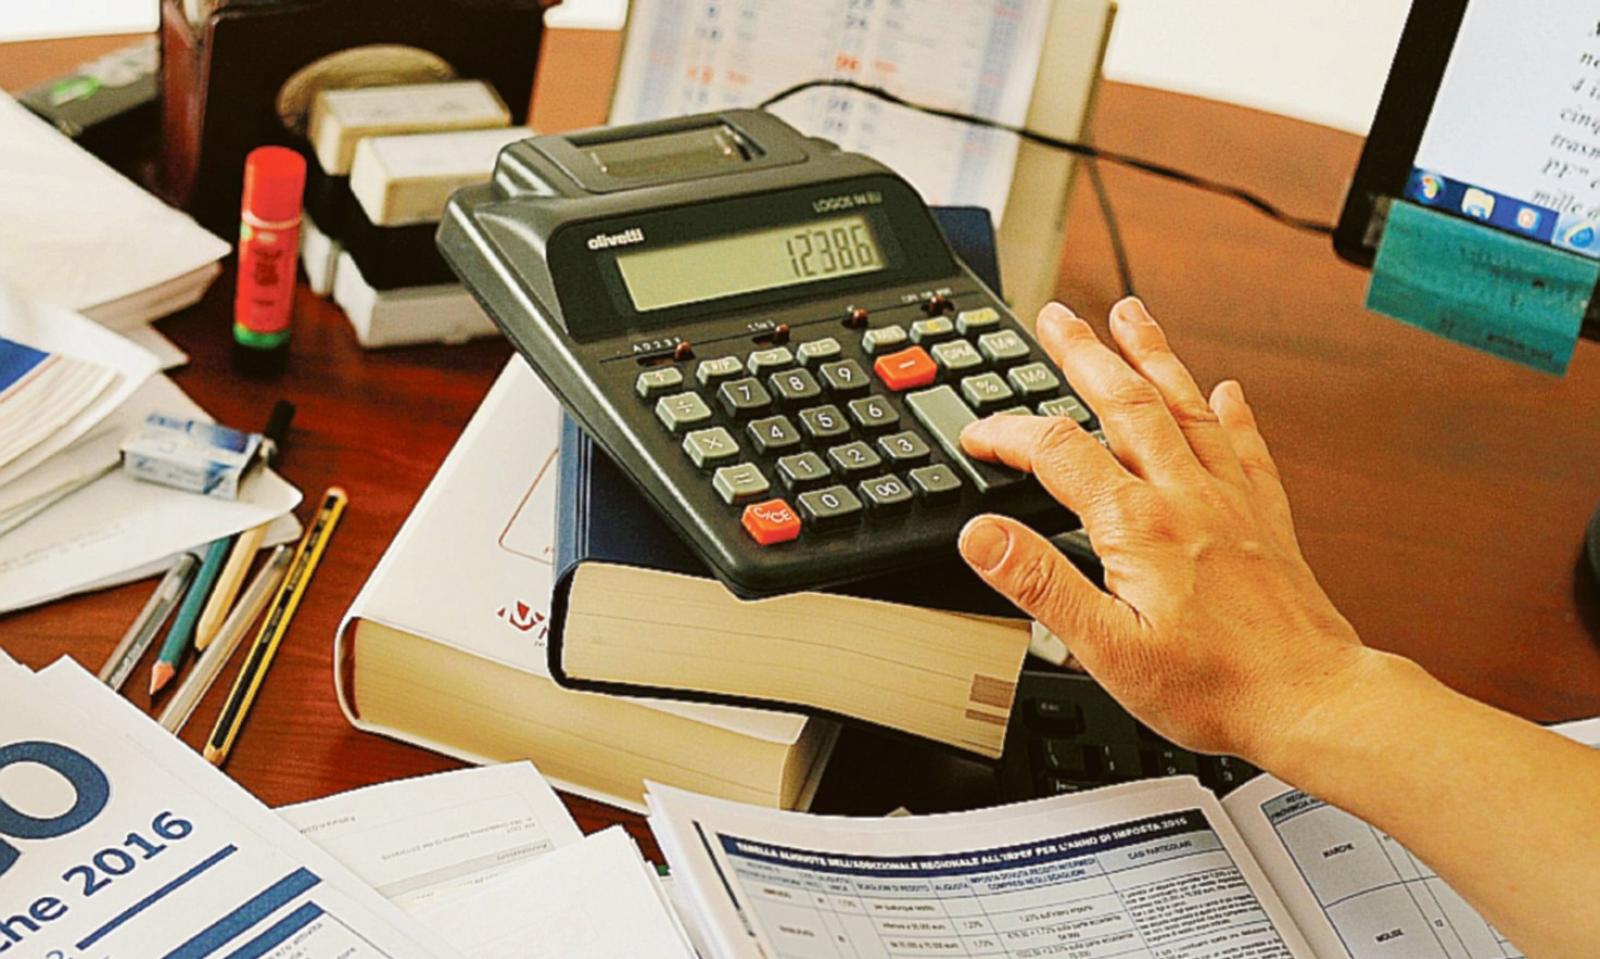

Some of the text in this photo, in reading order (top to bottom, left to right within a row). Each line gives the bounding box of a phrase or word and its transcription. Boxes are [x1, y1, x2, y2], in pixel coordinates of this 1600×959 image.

[586, 228, 645, 251] olivetti
[837, 366, 852, 382] 9
[788, 375, 805, 392] 8
[738, 385, 751, 401] 7
[868, 403, 884, 418] 6
[817, 412, 834, 428] 5
[770, 425, 784, 439] 4
[896, 438, 914, 452] 3
[847, 448, 866, 462] 2
[798, 460, 813, 473] 1
[821, 493, 840, 508] 0
[753, 506, 793, 524] C/CE
[1035, 845, 1058, 857] PER
[1100, 834, 1112, 844] DI
[1113, 823, 1161, 840] IMPOSTA
[62, 811, 193, 897] 2016
